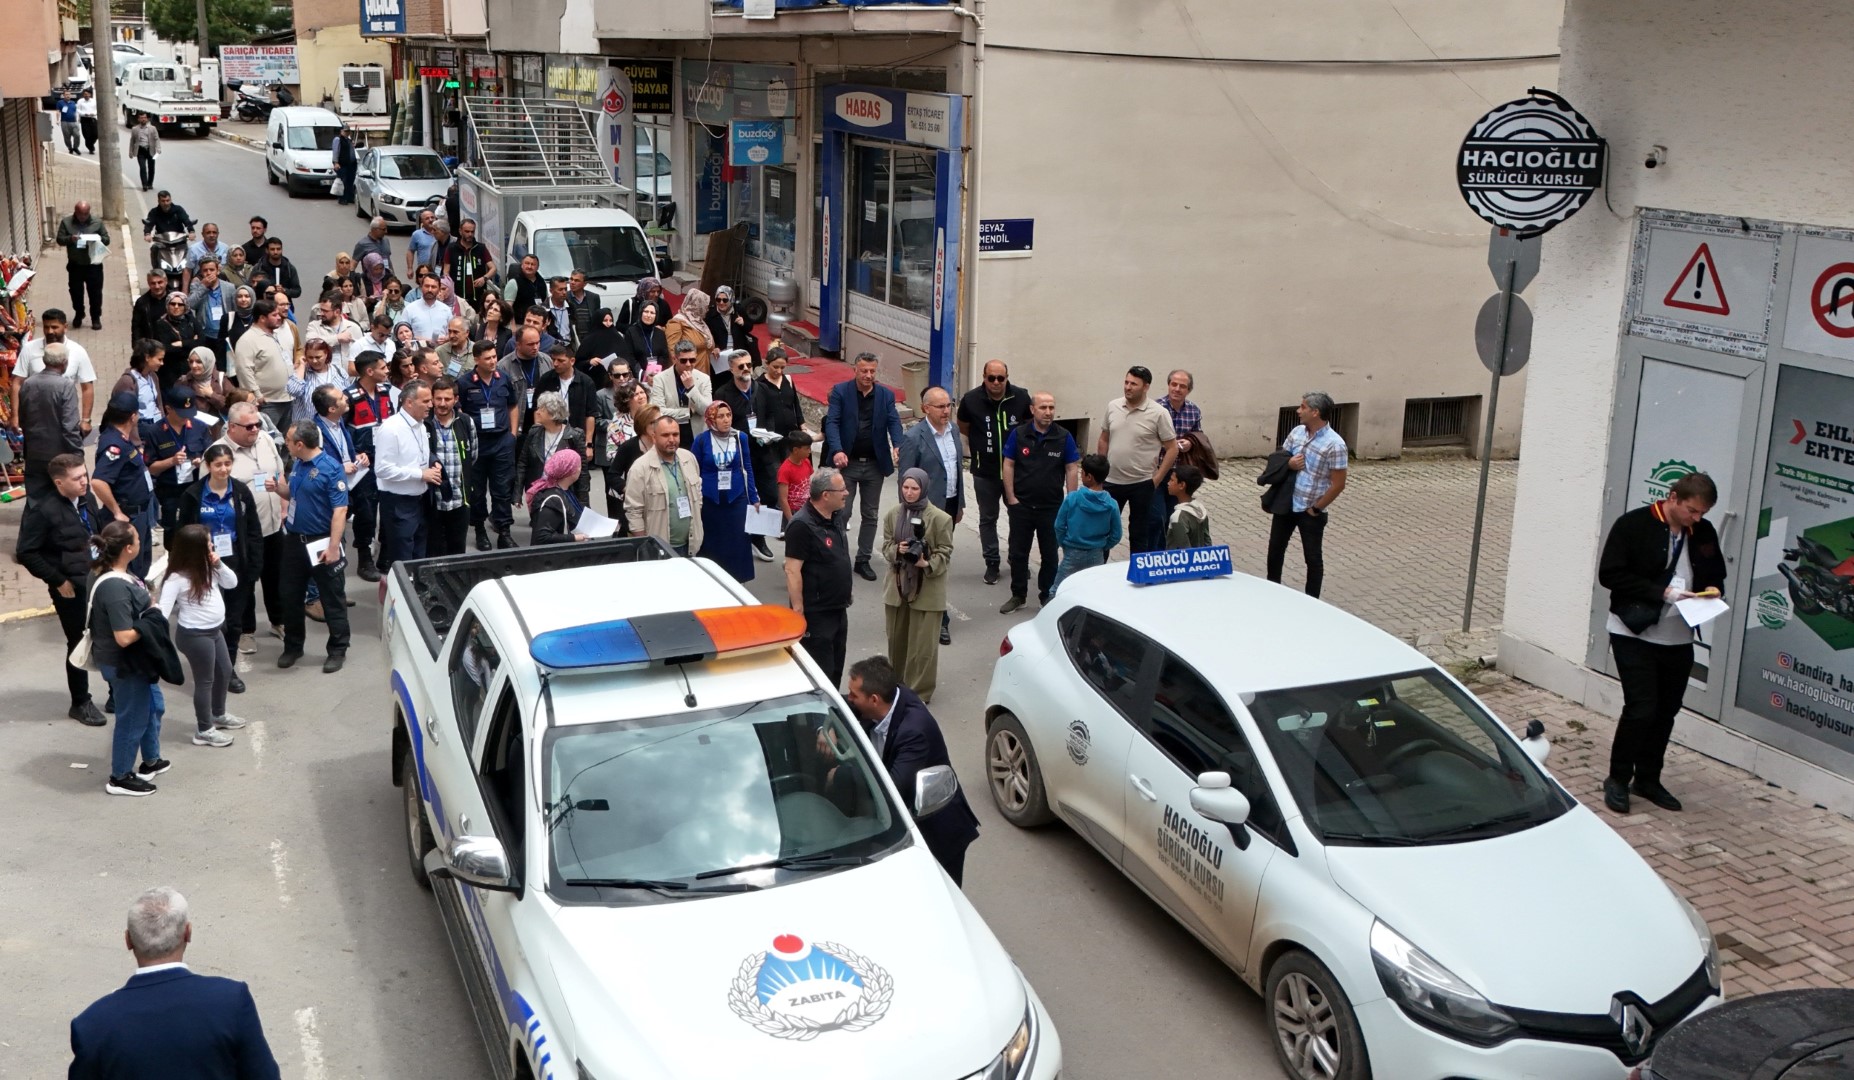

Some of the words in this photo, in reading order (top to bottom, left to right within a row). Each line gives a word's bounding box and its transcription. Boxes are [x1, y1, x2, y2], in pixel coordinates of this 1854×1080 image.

[623, 65, 657, 79] GÜVEN
[846, 97, 880, 120] HABAŞ
[738, 129, 776, 140] buzdağı
[1463, 147, 1597, 169] HACIOĞLU
[709, 152, 724, 211] buzdağı
[1468, 169, 1528, 184] SÜRÜCÜ
[1532, 174, 1584, 185] KURSU
[979, 233, 1010, 244] MENDİL
[980, 224, 1005, 232] BEYAZ
[1814, 421, 1854, 444] EHL
[1804, 440, 1854, 466] ERTE
[1136, 550, 1189, 569] SÜRÜCÜ
[1193, 549, 1229, 564] ADAYI
[1149, 566, 1186, 577] EĞİTİM
[1189, 563, 1220, 573] ARACI
[1793, 657, 1854, 694] kandira_ha
[1786, 698, 1854, 737] hacioglusur
[1163, 804, 1223, 870] HACIOĞLU
[1157, 827, 1192, 873] SÜRÜCÜ
[1194, 858, 1224, 902] KURSU
[788, 990, 846, 1007] ZABITA
